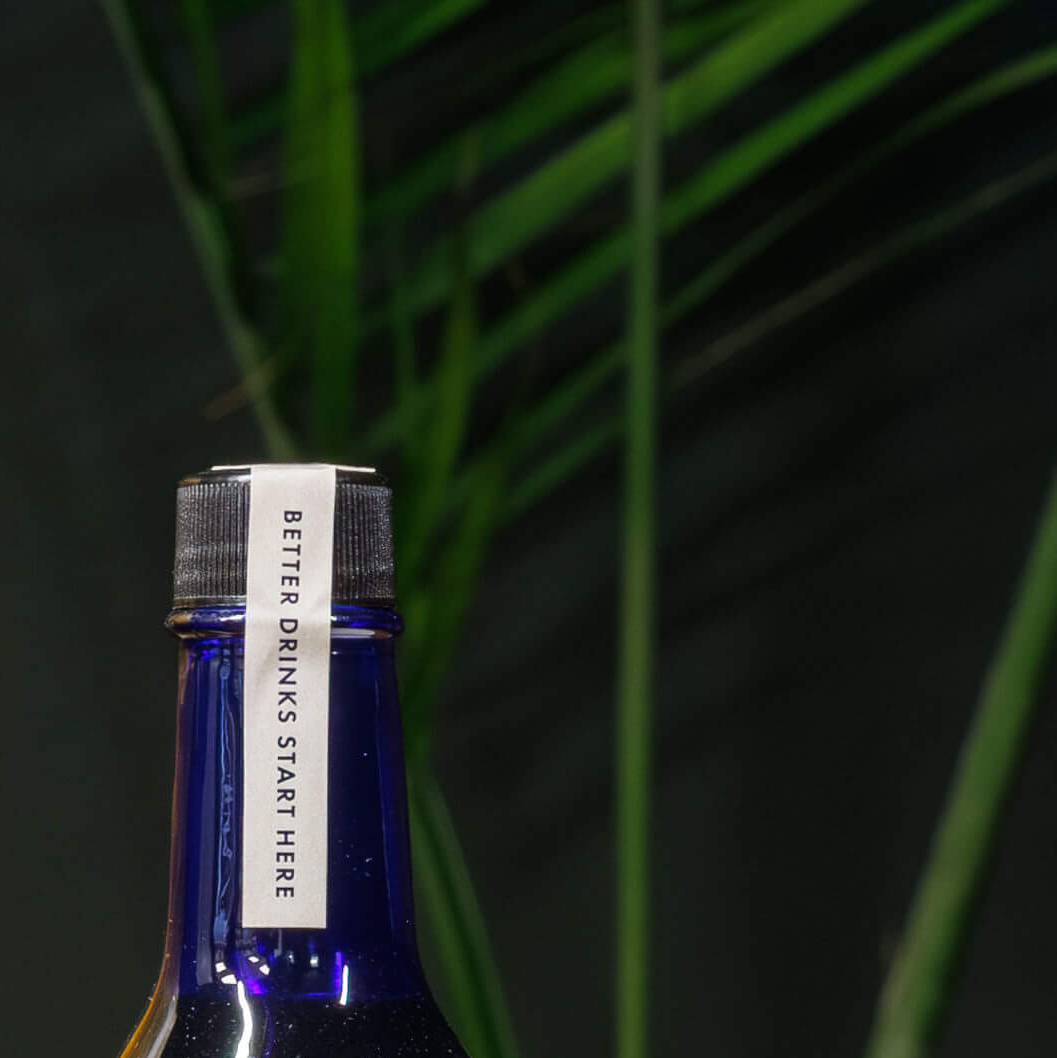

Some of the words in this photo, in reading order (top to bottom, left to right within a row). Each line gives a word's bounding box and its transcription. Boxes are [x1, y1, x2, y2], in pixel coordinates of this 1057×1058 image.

[280, 510, 302, 605] BETTER
[277, 618, 299, 723] DRINKS
[276, 735, 297, 818] START
[275, 829, 295, 899] HERE
